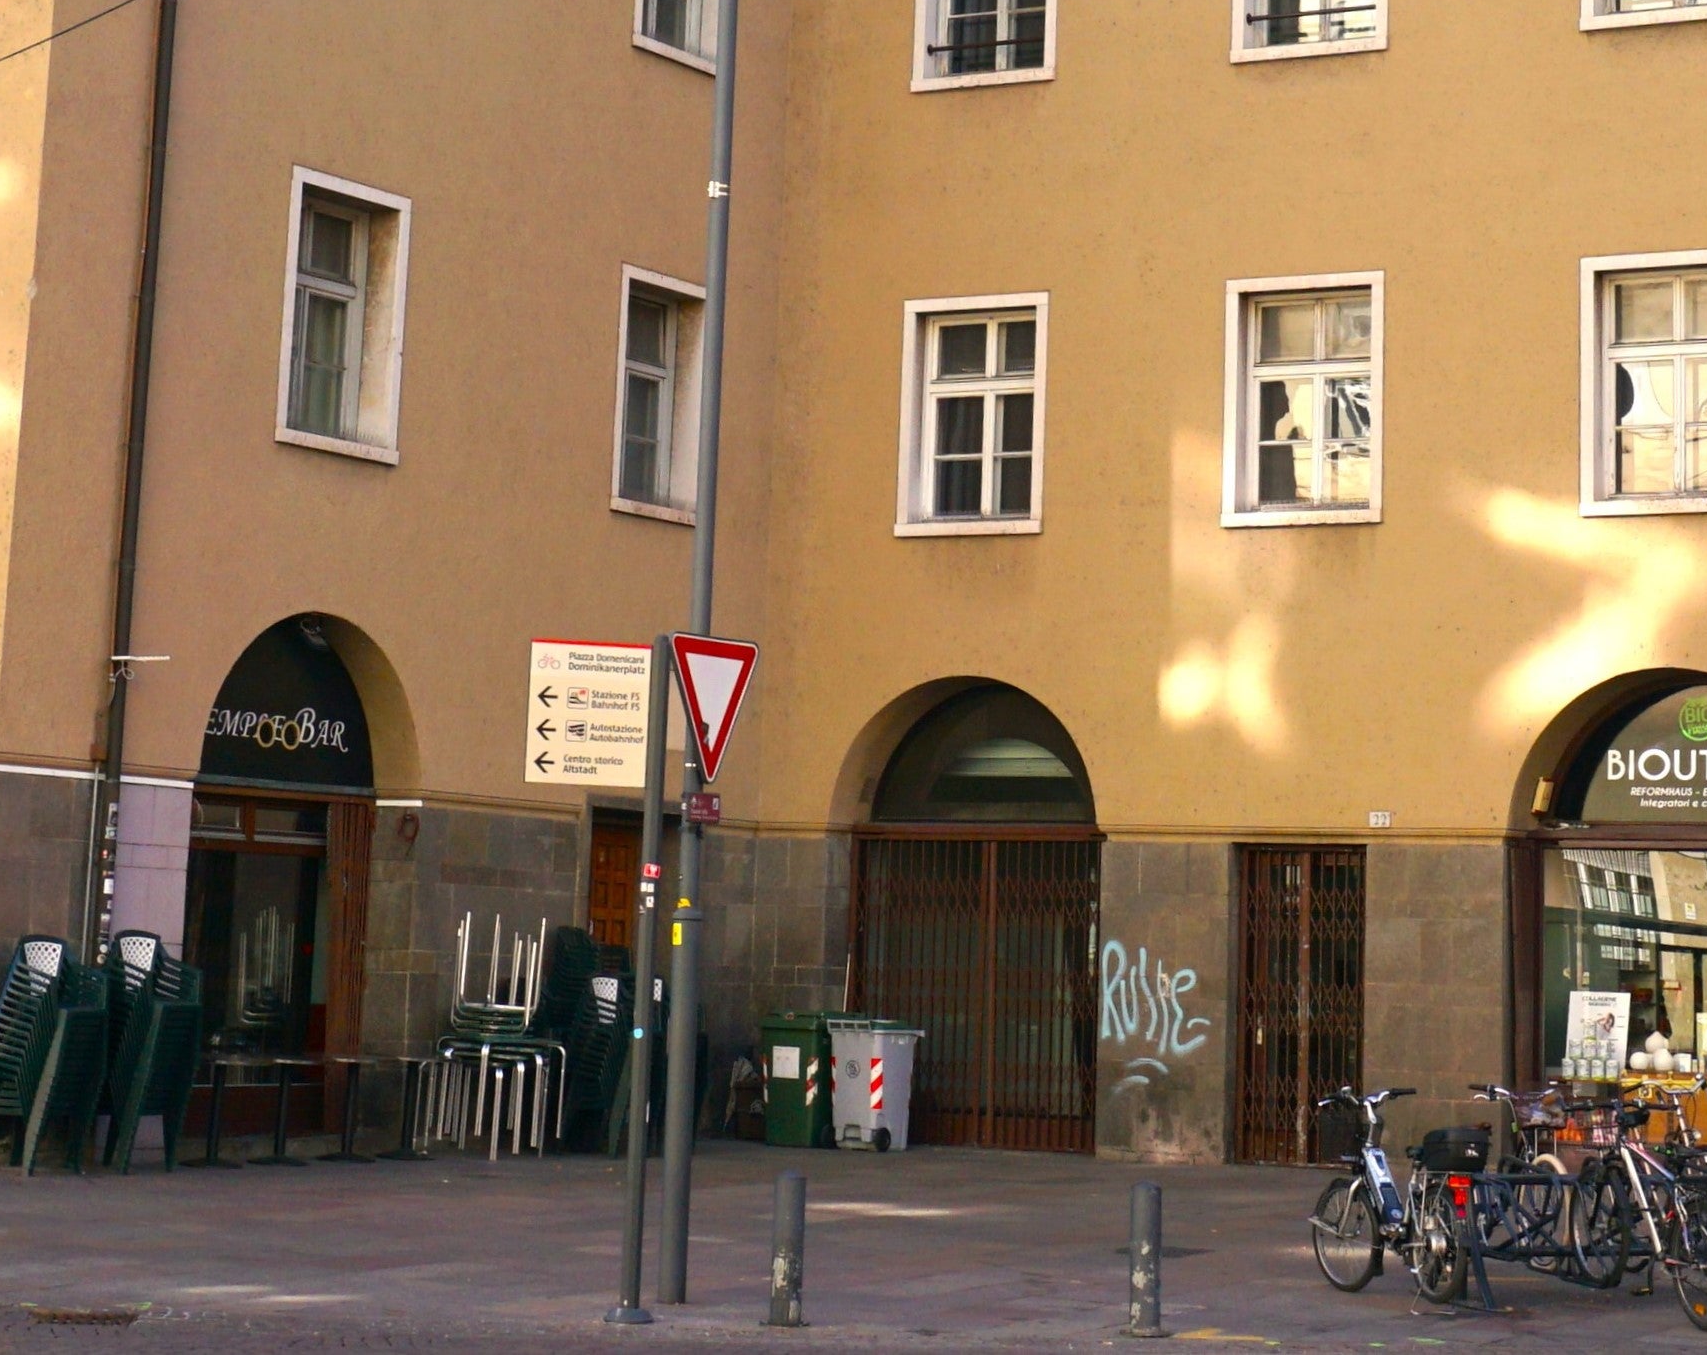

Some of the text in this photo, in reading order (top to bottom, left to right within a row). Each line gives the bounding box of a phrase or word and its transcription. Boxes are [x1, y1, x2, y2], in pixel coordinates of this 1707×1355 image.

[569, 651, 644, 664] Piazza Domenicani
[568, 662, 645, 675] Dominikanerplatz
[591, 690, 640, 701] Stazione FS
[591, 701, 640, 711] Bahnhof FS
[590, 723, 643, 734] Autostazione
[589, 733, 644, 744] Autobahnhof
[563, 754, 623, 766] Centro storico
[563, 765, 597, 775] Altstadt
[1630, 786, 1693, 796] REFORMHAUS
[1640, 798, 1690, 809] Integratori
[1692, 800, 1699, 808] e
[1373, 813, 1387, 825] 22
